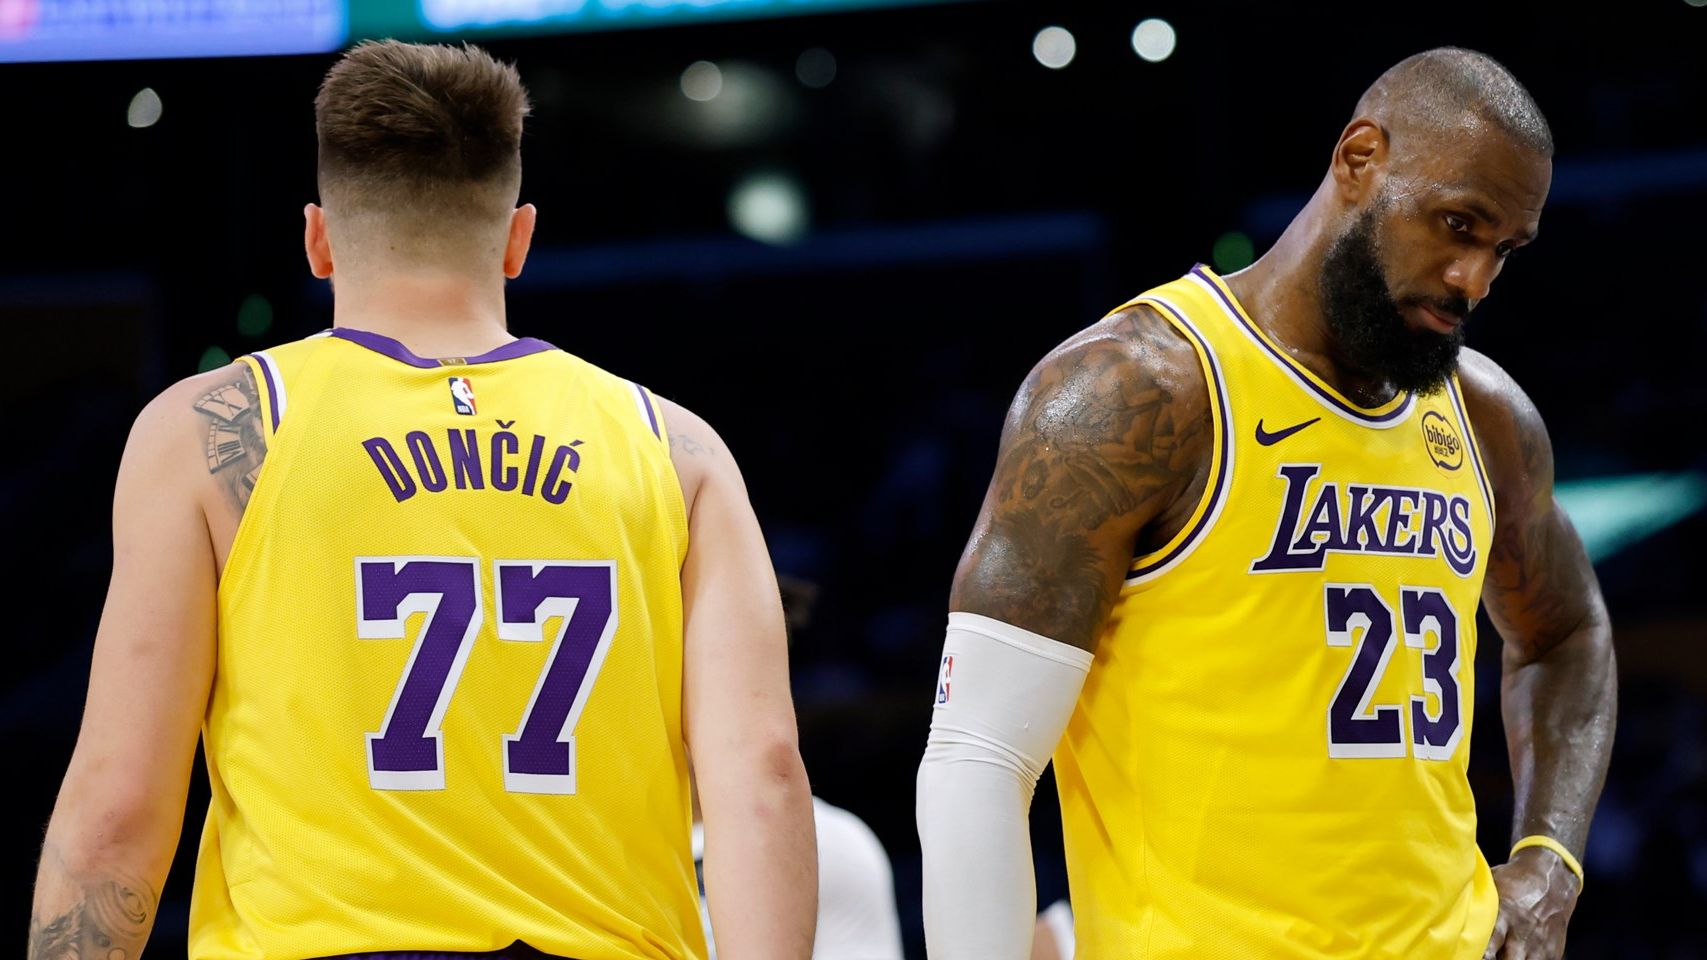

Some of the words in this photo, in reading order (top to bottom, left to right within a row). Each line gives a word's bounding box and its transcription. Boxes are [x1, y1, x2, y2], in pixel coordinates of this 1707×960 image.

[361, 419, 585, 505] DONČIĆ
[1425, 424, 1460, 455] bibigo
[1248, 463, 1476, 578] LAKERS
[354, 555, 620, 795] 77
[1324, 582, 1464, 761] 23
